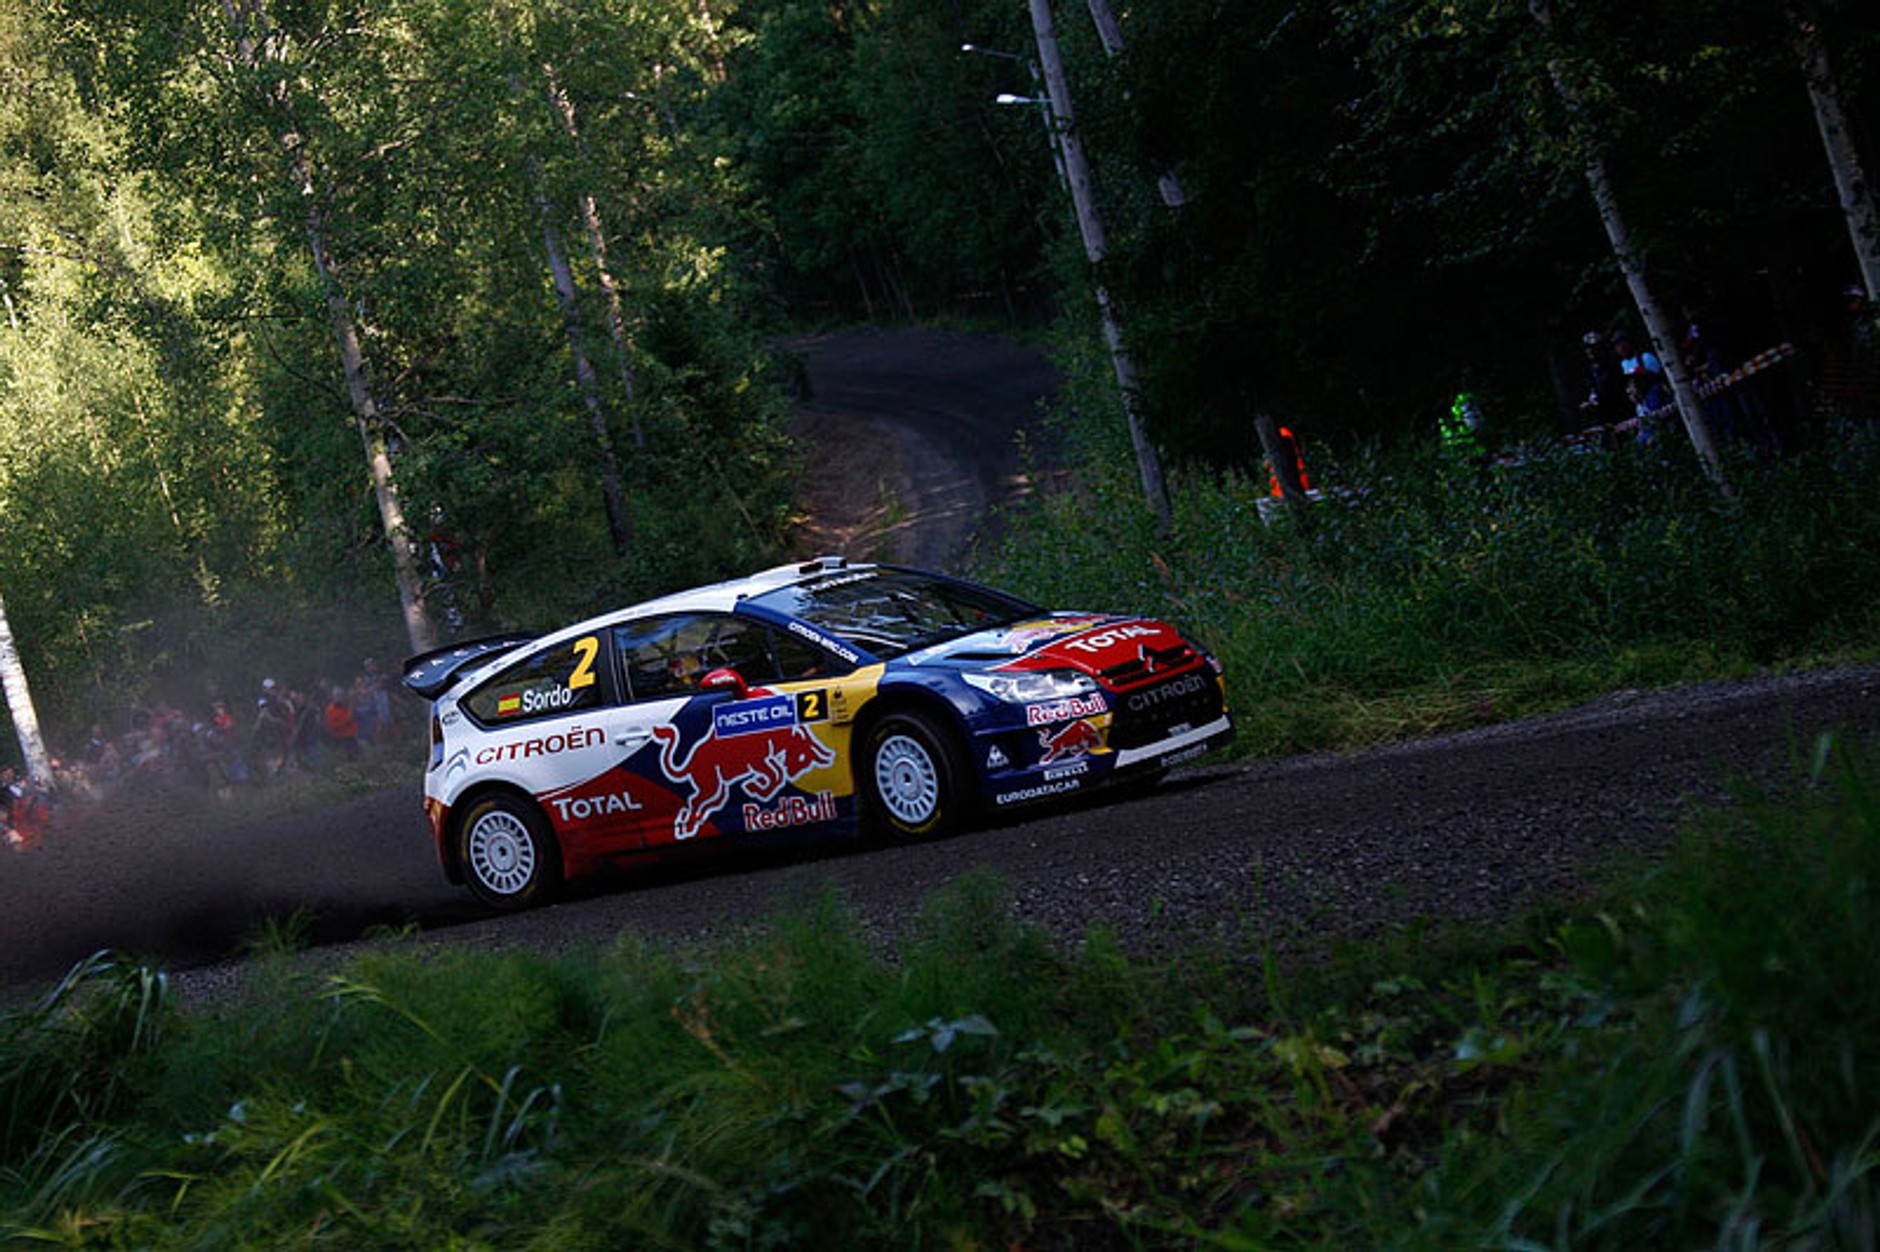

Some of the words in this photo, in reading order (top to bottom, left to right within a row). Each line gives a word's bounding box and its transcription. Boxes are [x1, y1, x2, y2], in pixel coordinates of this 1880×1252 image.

[569, 636, 600, 689] 2
[522, 685, 573, 711] Sordo
[802, 691, 820, 719] 2
[1027, 701, 1069, 725] Red
[1069, 691, 1109, 716] Bull
[1127, 673, 1208, 713] CITROËN
[770, 704, 794, 720] OIL
[476, 725, 606, 765] CITROËN
[552, 791, 643, 822] TOTAL
[743, 801, 791, 832] Red
[790, 791, 837, 824] Bull
